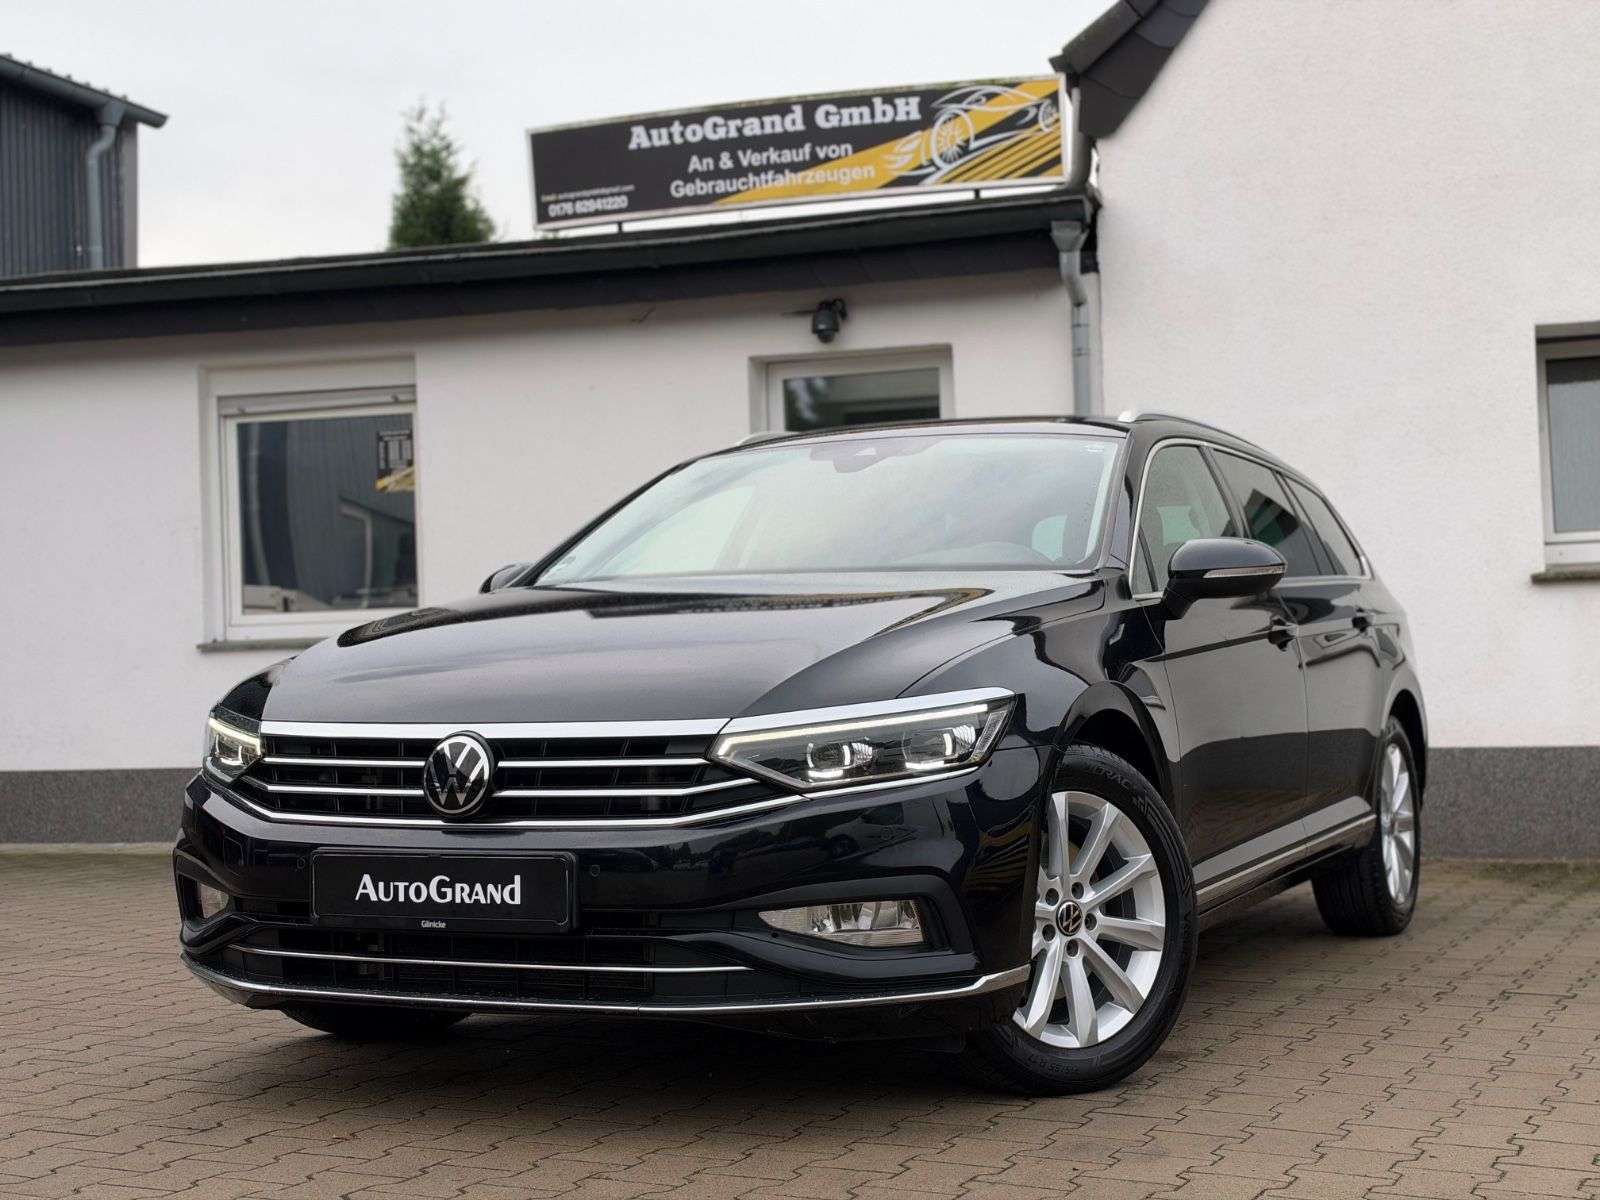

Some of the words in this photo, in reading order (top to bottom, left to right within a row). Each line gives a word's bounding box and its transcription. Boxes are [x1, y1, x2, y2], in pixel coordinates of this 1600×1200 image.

[628, 104, 806, 150] AutoGrand
[814, 95, 922, 128] GmbH
[687, 154, 715, 173] An
[719, 151, 735, 169] &
[737, 143, 813, 167] Verkauf
[815, 142, 853, 160] von
[669, 164, 877, 198] Gebrauchtfahrzeugen
